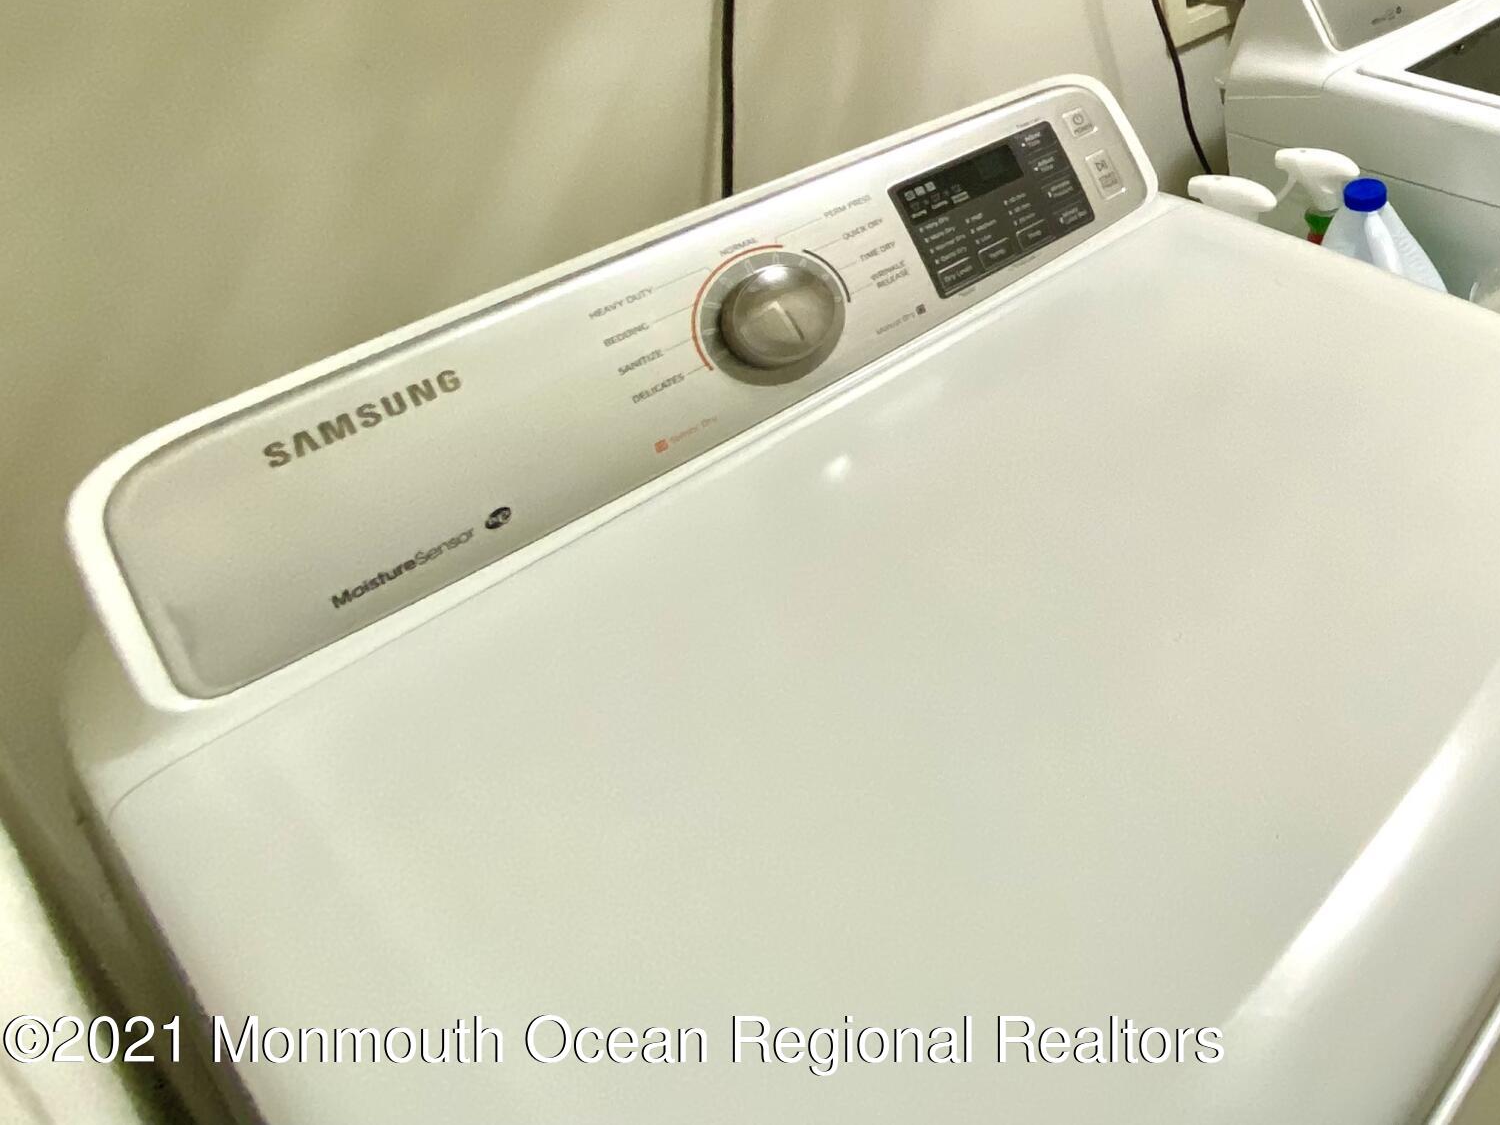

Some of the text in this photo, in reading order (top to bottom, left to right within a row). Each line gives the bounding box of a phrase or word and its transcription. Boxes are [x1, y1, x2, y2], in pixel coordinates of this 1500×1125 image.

[588, 285, 655, 320] HEAVY DUTY
[603, 322, 650, 348] BEDDING
[617, 348, 664, 377] SANITIZE
[632, 373, 685, 404] DELICATES
[262, 369, 463, 469] SAMSUNG
